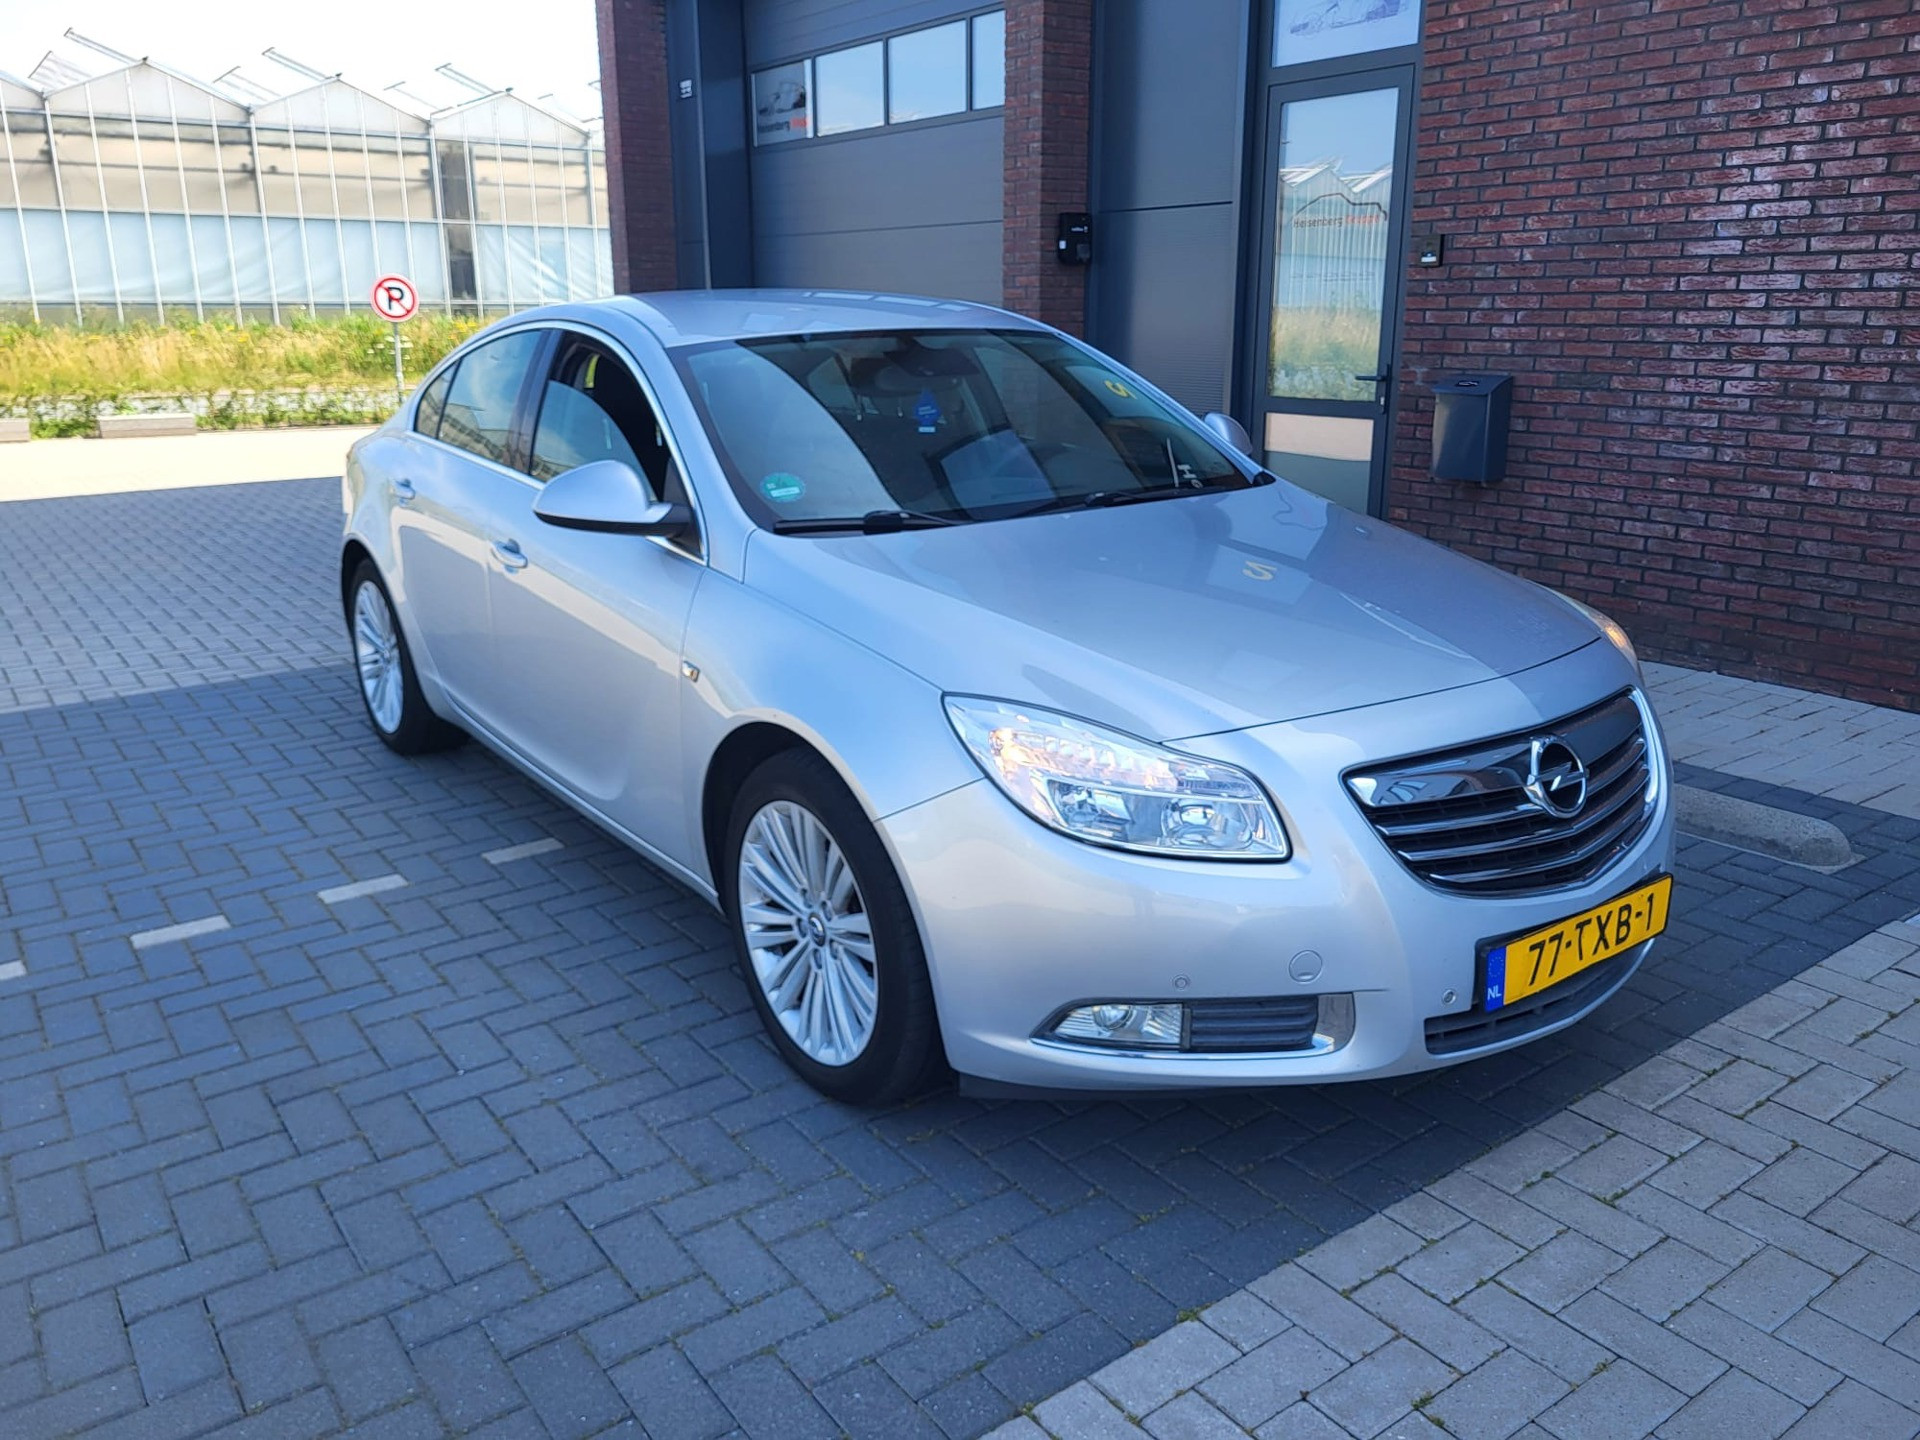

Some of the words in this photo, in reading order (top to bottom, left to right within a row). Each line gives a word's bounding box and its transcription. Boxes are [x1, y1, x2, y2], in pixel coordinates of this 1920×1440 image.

[388, 286, 404, 310] P
[1528, 892, 1655, 987] 77-TXB-1
[1487, 985, 1502, 1001] NL
